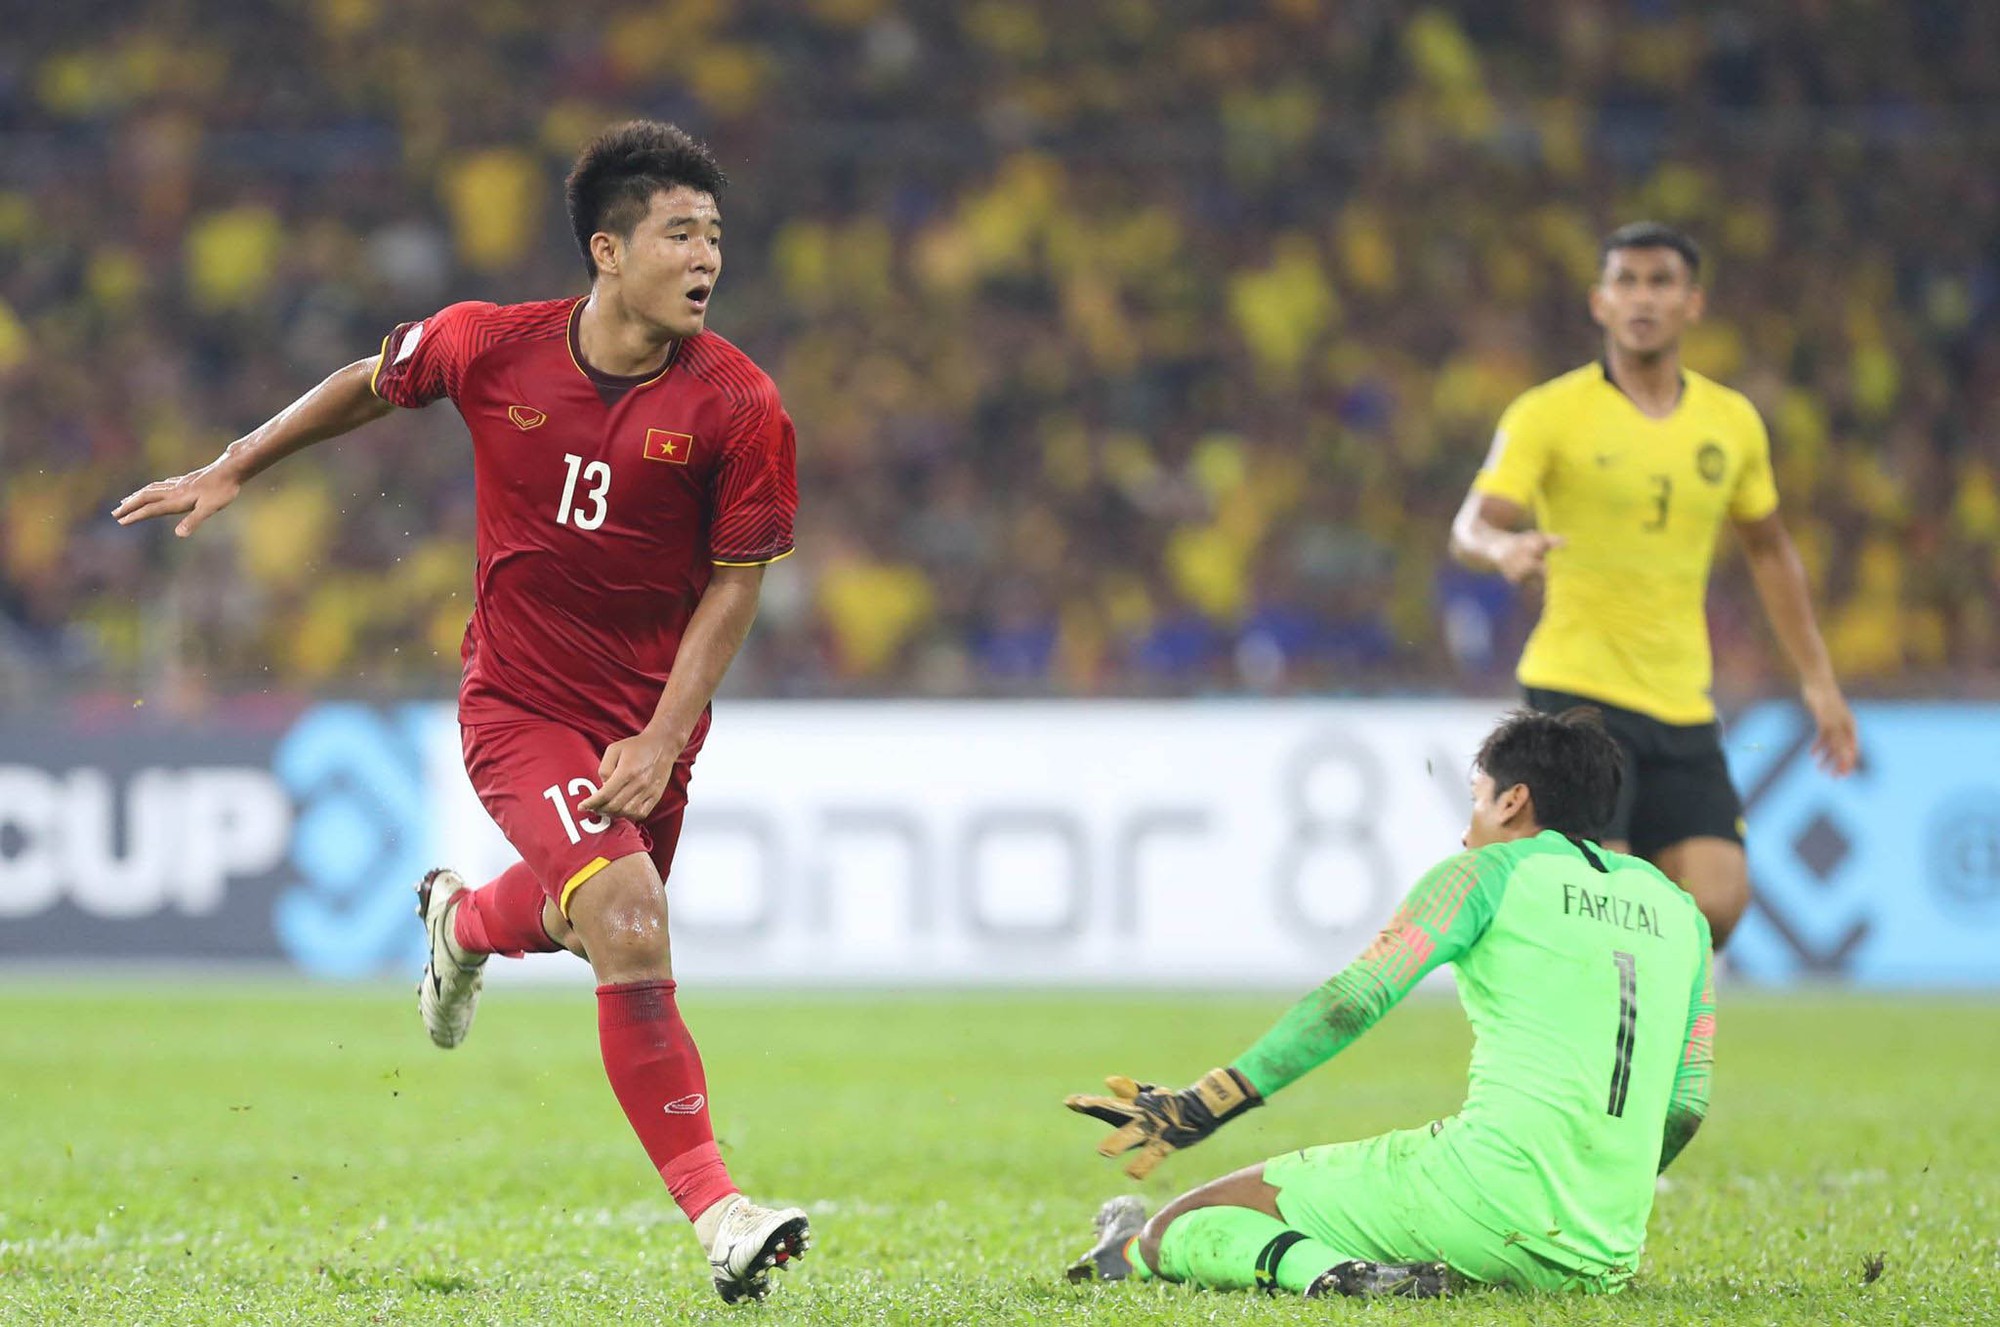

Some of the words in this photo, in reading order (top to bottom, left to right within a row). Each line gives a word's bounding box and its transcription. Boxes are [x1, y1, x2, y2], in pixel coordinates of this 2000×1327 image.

[555, 452, 612, 531] 13
[1643, 473, 1673, 534] 3
[0, 761, 293, 919] CUP
[542, 777, 612, 846] 13
[667, 803, 1221, 943] onor
[1562, 883, 1666, 940] FARIZAL
[1606, 949, 1638, 1119] 1
